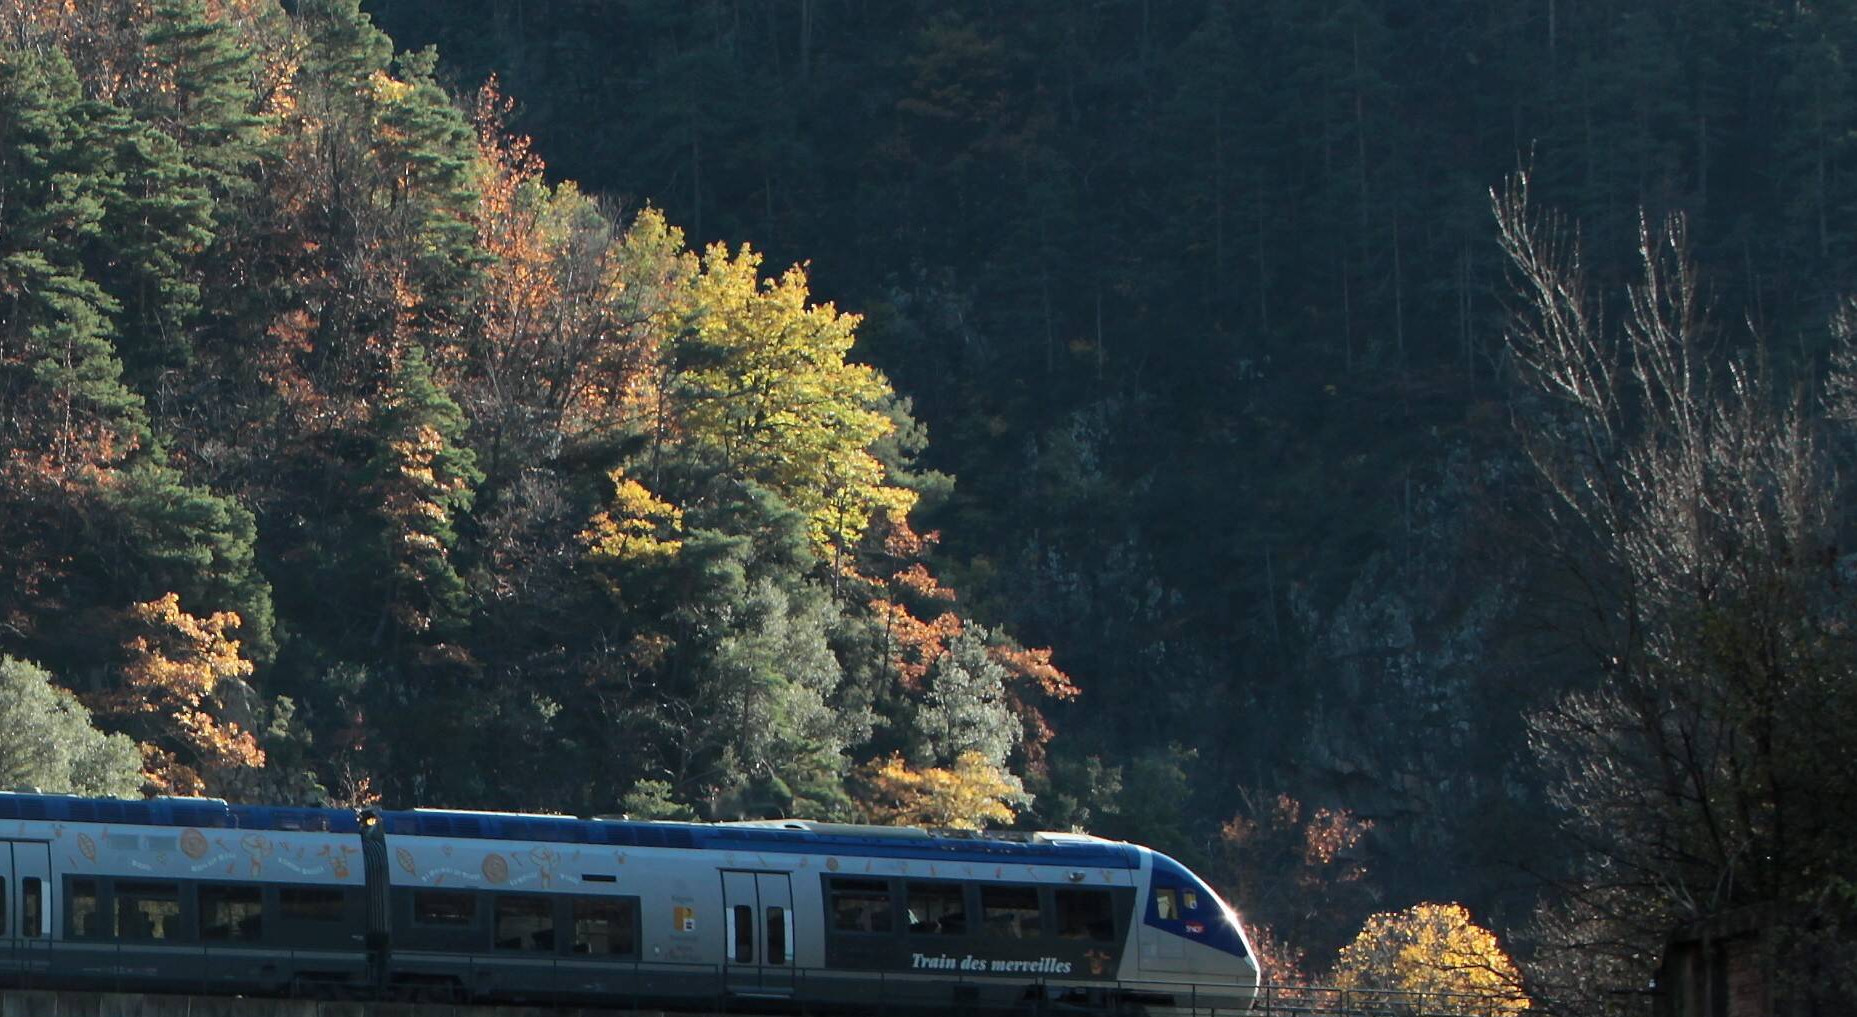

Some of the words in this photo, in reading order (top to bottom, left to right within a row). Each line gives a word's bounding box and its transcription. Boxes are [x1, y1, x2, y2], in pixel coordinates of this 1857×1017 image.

[912, 952, 957, 968] Train
[961, 954, 987, 970] des
[991, 957, 1073, 973] merveilles
